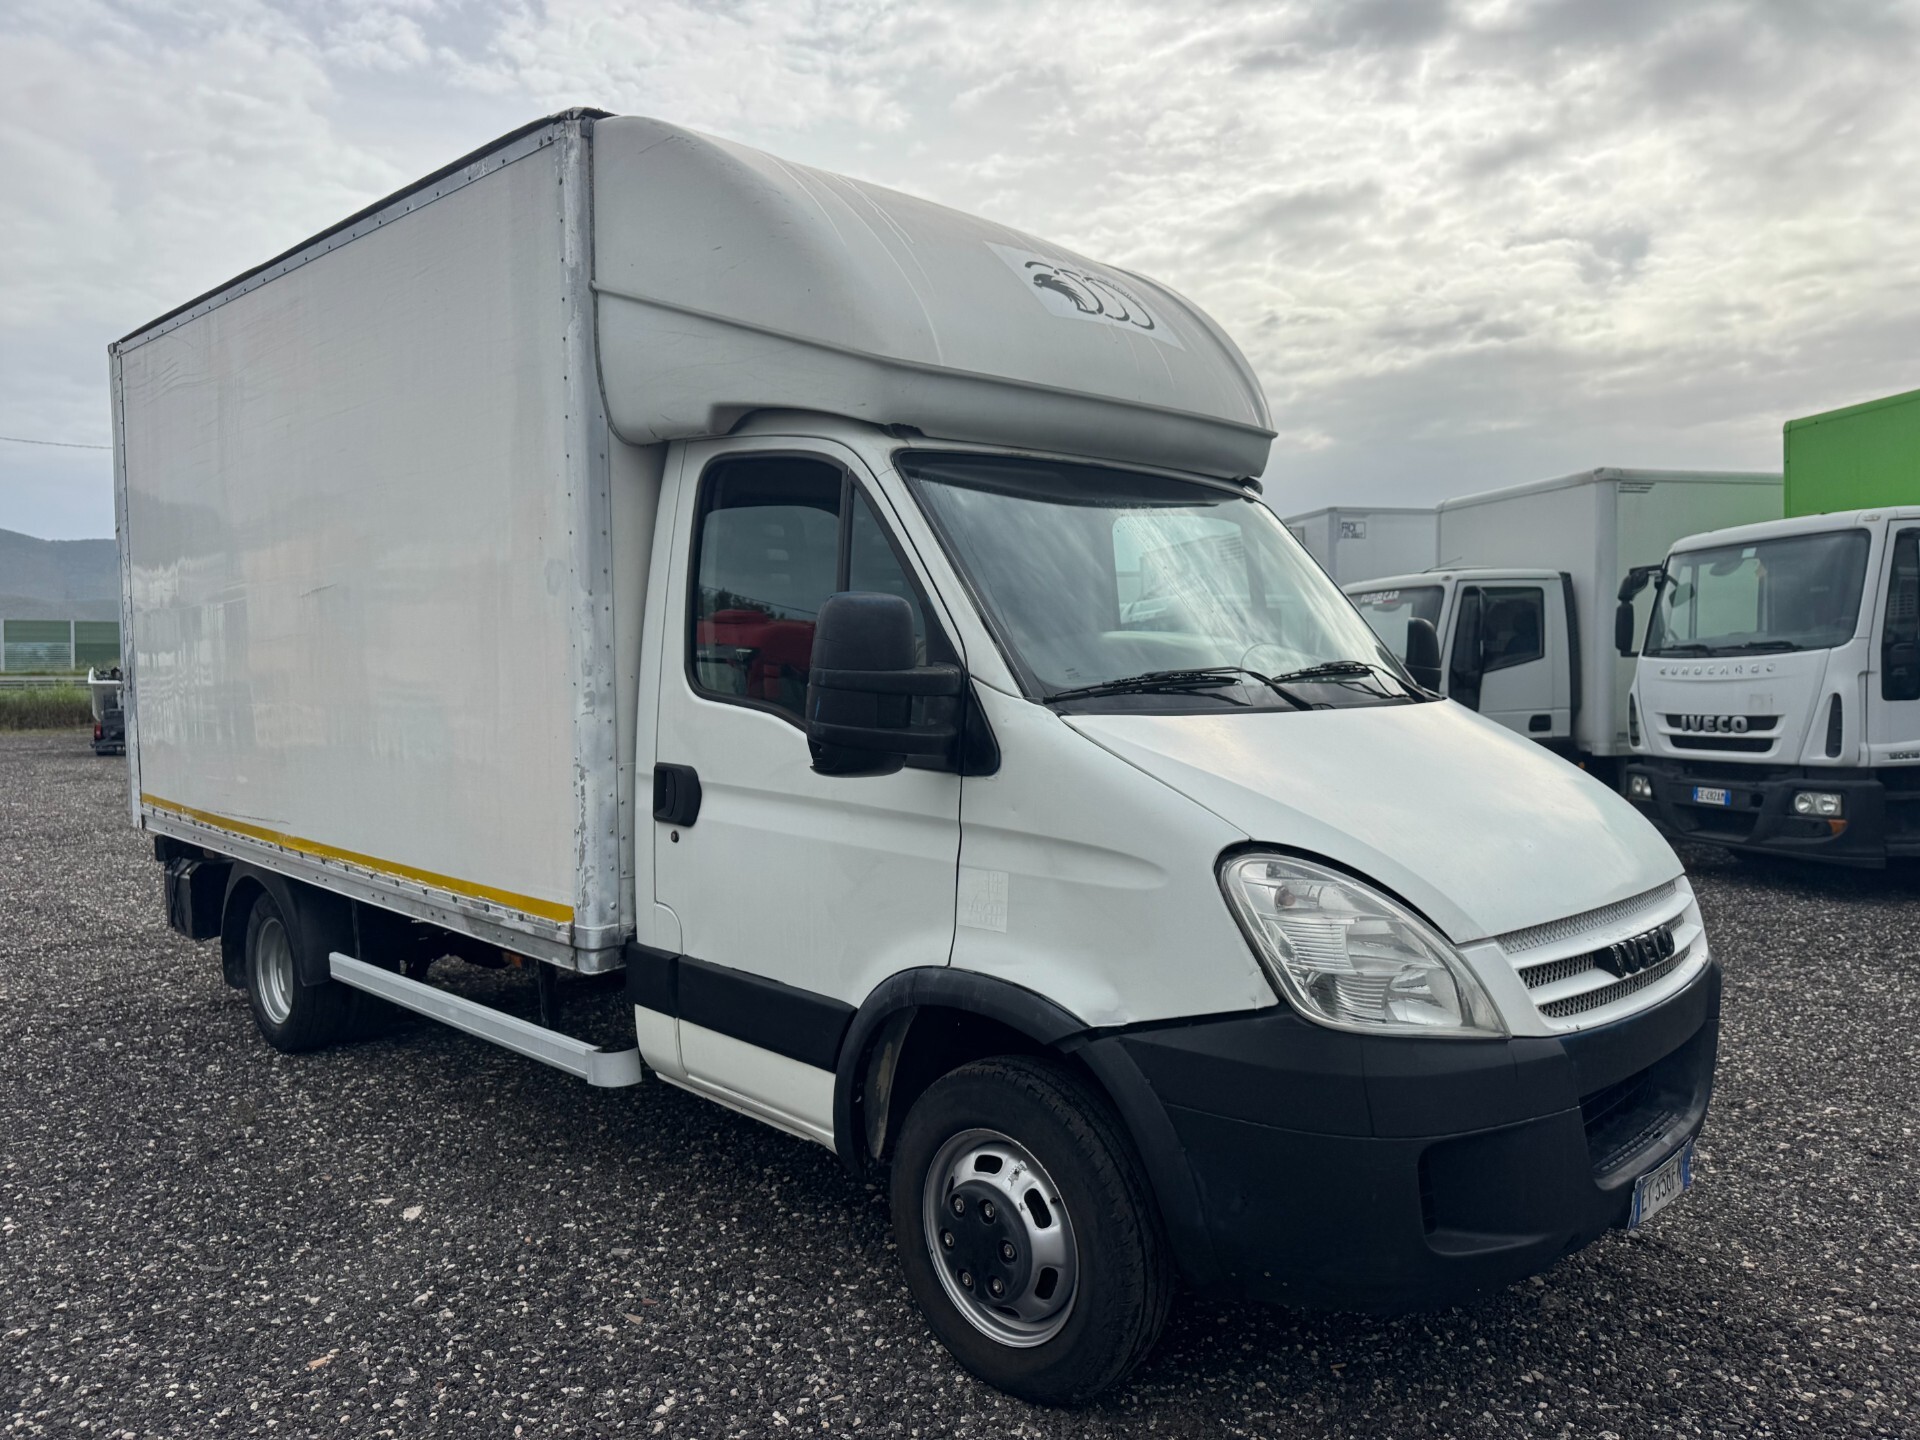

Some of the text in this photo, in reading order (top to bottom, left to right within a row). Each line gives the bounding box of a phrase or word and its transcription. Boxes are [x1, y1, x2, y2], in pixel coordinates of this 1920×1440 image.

[1659, 663, 1777, 676] EUROCARGO
[1680, 714, 1748, 734] IVECO
[1606, 924, 1675, 979] IVECO
